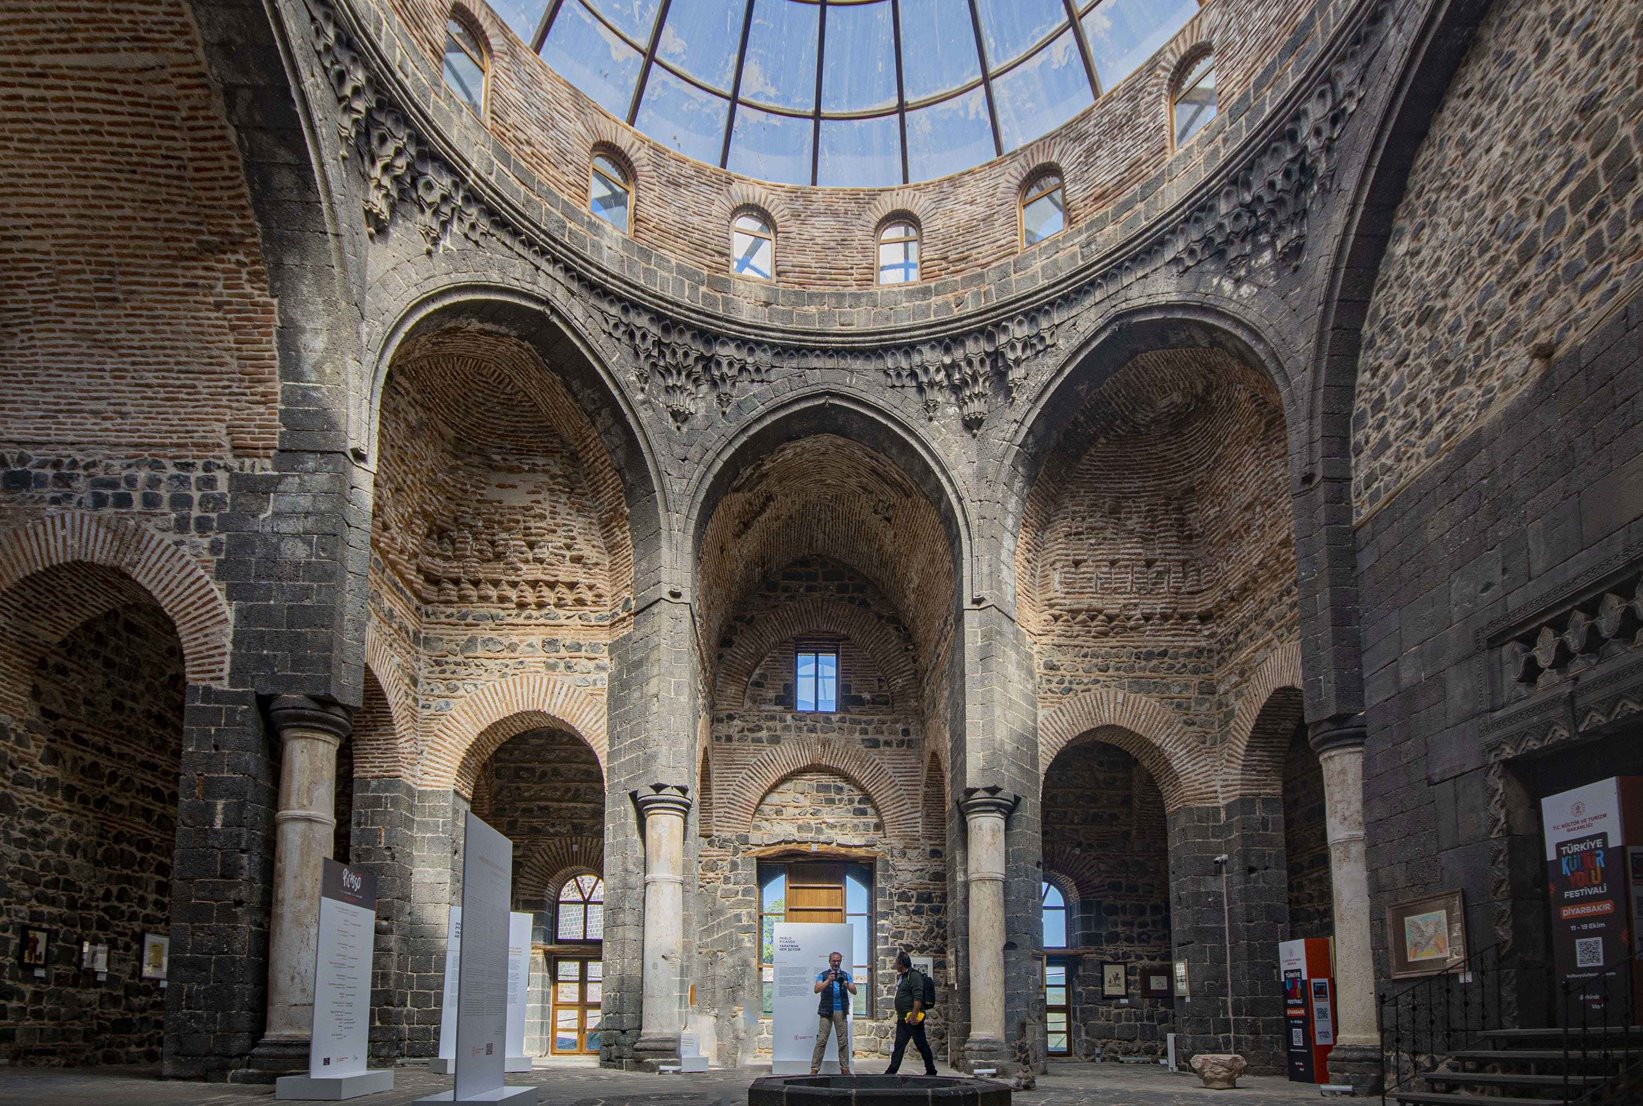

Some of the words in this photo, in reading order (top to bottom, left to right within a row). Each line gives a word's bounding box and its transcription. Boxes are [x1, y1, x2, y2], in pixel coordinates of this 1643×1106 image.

[1561, 839, 1603, 855] TÜRKİYE
[1564, 883, 1607, 899] FESTİVALİ
[1562, 903, 1612, 917] DİYARBAKIR
